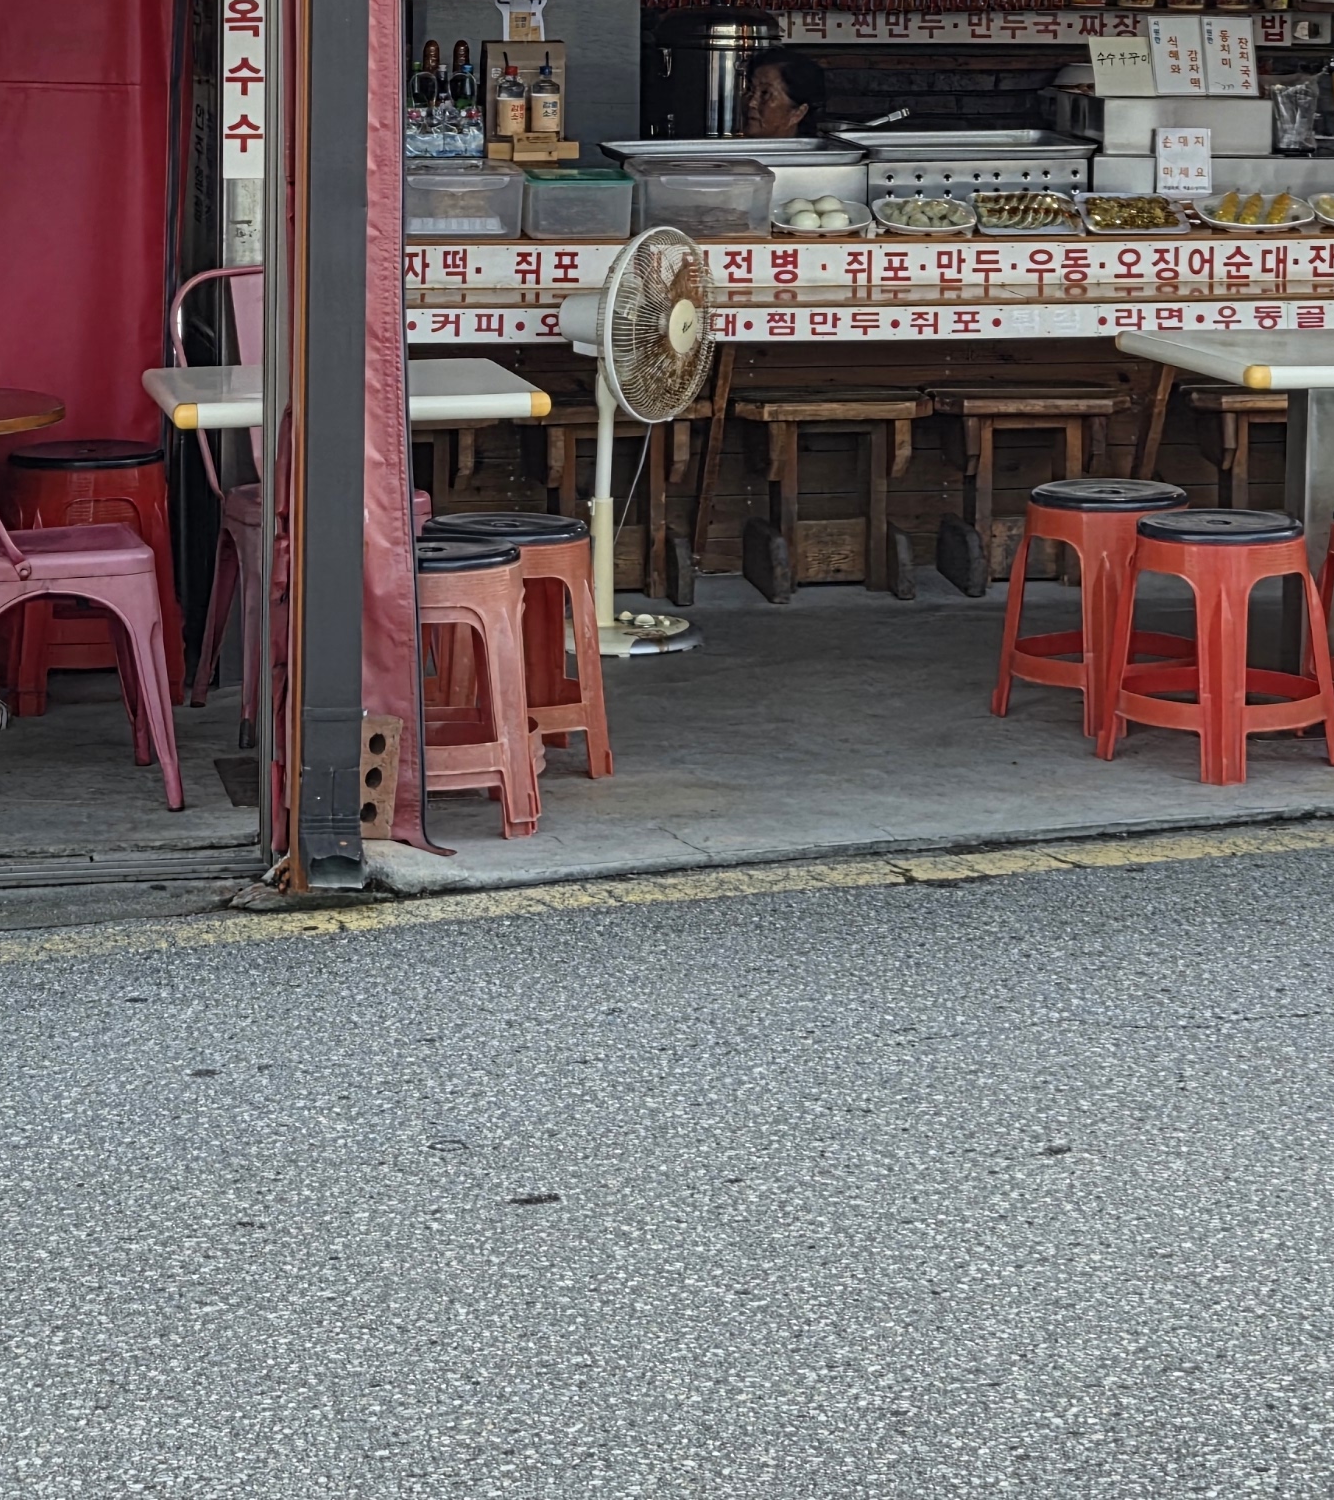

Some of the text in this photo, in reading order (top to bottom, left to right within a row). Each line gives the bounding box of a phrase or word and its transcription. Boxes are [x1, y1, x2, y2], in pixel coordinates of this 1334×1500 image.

[515, 250, 581, 286] 쥐포
[844, 249, 912, 285] 쥐포
[935, 248, 1004, 285] 만두
[1026, 248, 1093, 284] 우동
[1113, 245, 1289, 282] 오징어순대
[430, 312, 505, 338] 커피
[766, 311, 881, 338] 찜만두
[909, 310, 982, 336] 쥐포
[1114, 305, 1186, 332] 라면
[1211, 304, 1284, 331] 우동
